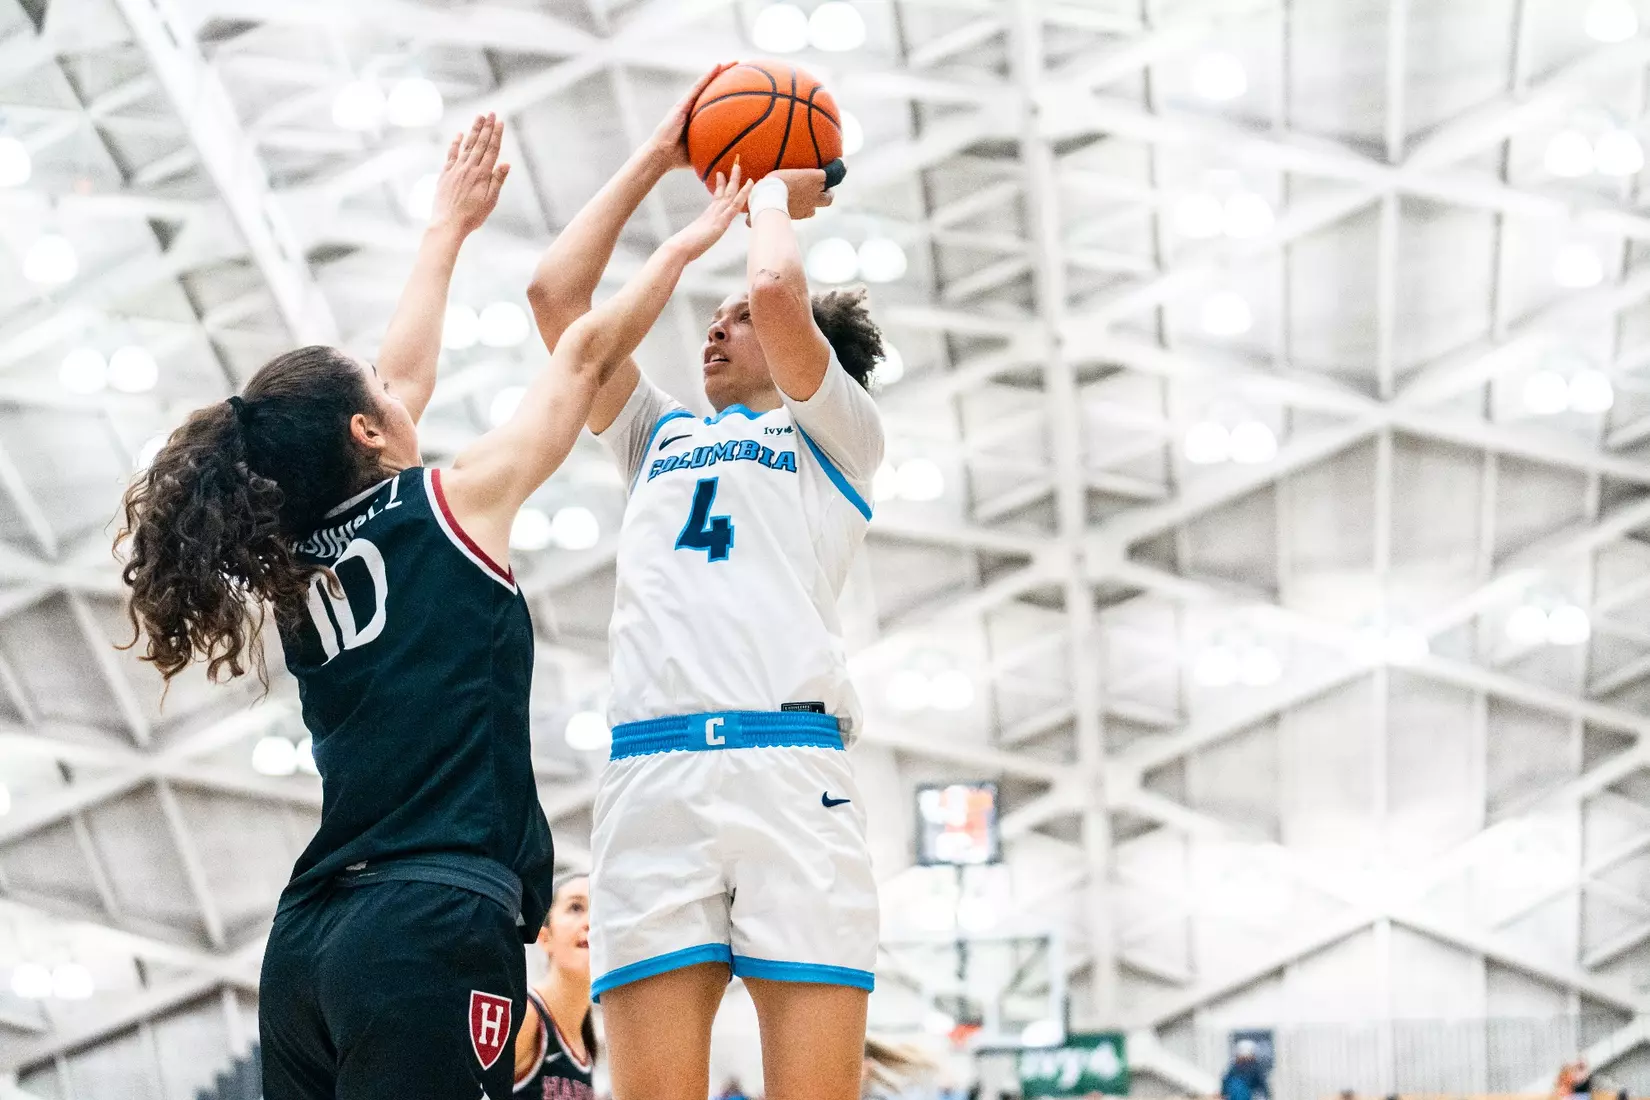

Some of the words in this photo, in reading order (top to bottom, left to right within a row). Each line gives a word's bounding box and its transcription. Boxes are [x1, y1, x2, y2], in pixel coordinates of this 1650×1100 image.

[763, 426, 787, 435] Ivy
[647, 440, 797, 483] COLUMBIA
[675, 476, 734, 562] 4
[307, 538, 388, 666] 10
[705, 717, 726, 746] C
[479, 1003, 503, 1047] H
